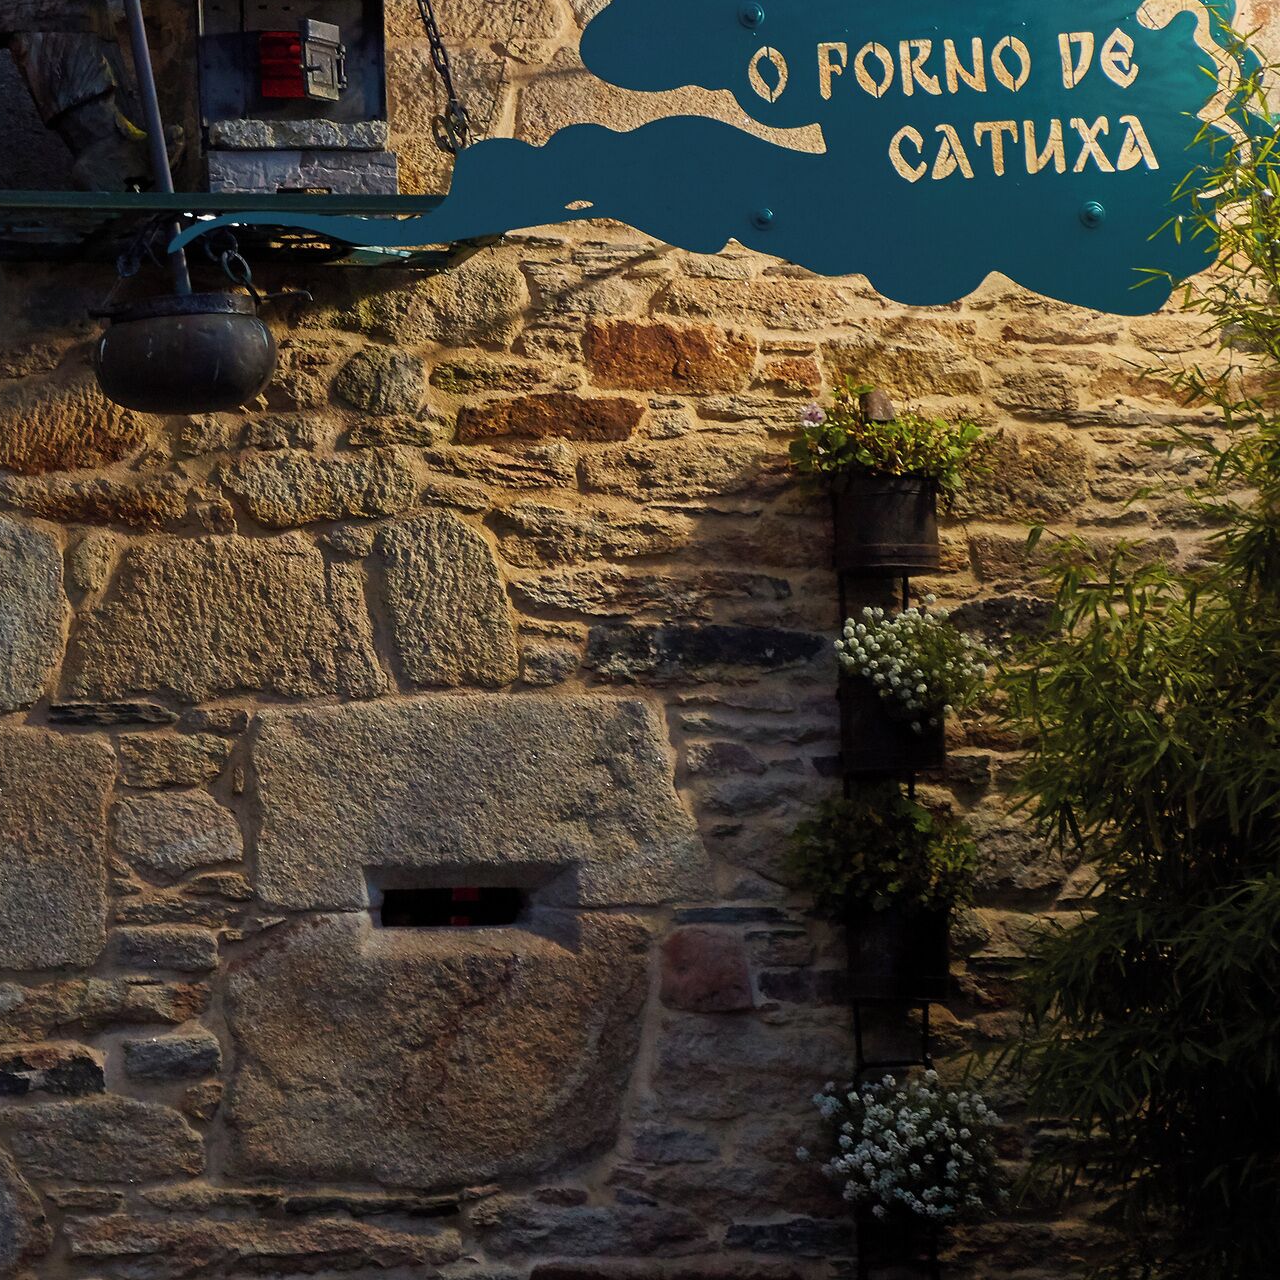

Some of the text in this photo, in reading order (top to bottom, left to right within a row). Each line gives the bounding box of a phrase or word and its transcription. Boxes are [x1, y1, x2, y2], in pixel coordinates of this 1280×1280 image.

[748, 27, 1139, 103] O FORNO DE
[888, 115, 1159, 183] CATUXA
